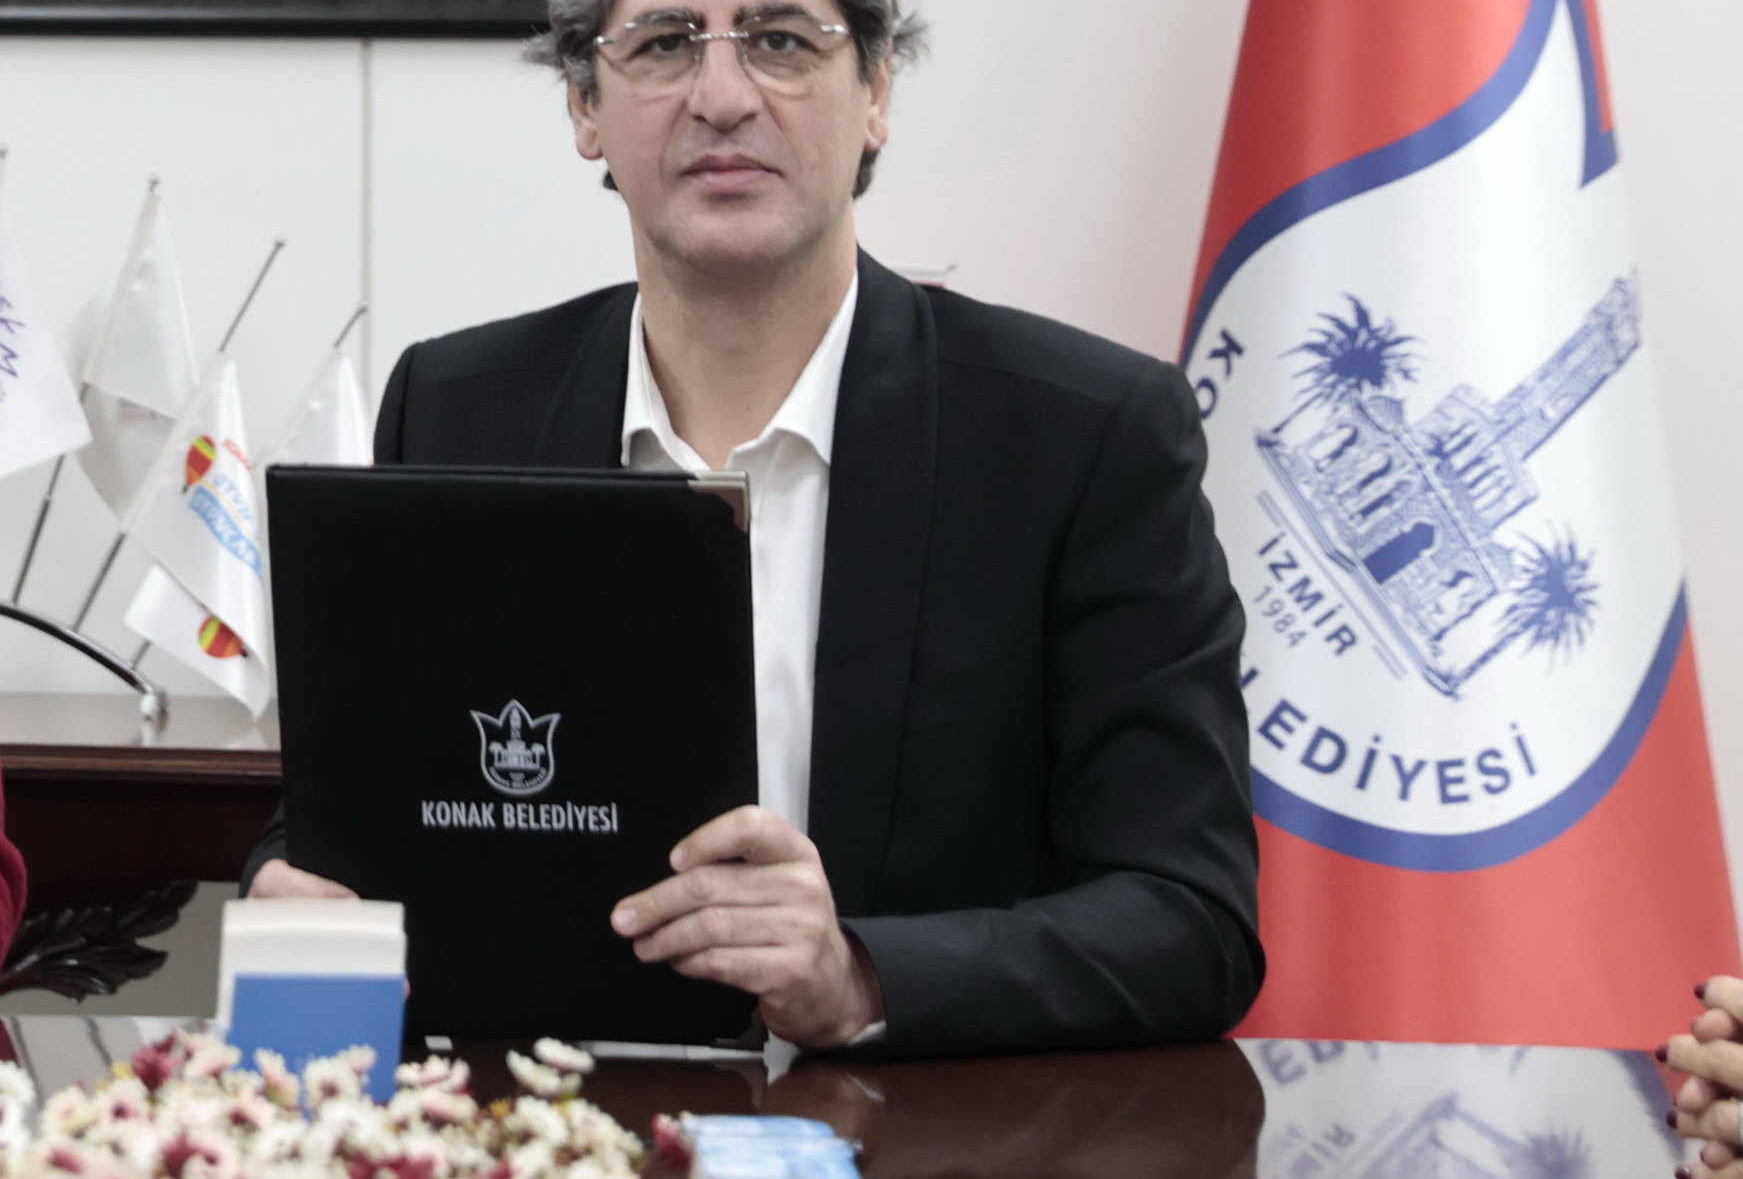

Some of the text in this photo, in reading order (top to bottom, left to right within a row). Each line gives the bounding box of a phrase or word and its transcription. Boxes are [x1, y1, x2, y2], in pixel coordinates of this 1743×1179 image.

[1253, 584, 1307, 648] 1984
[1258, 531, 1358, 656] İZMİR
[1241, 666, 1536, 805] EDİYESİ
[421, 799, 619, 834] KONAK BELEDİYESİ
